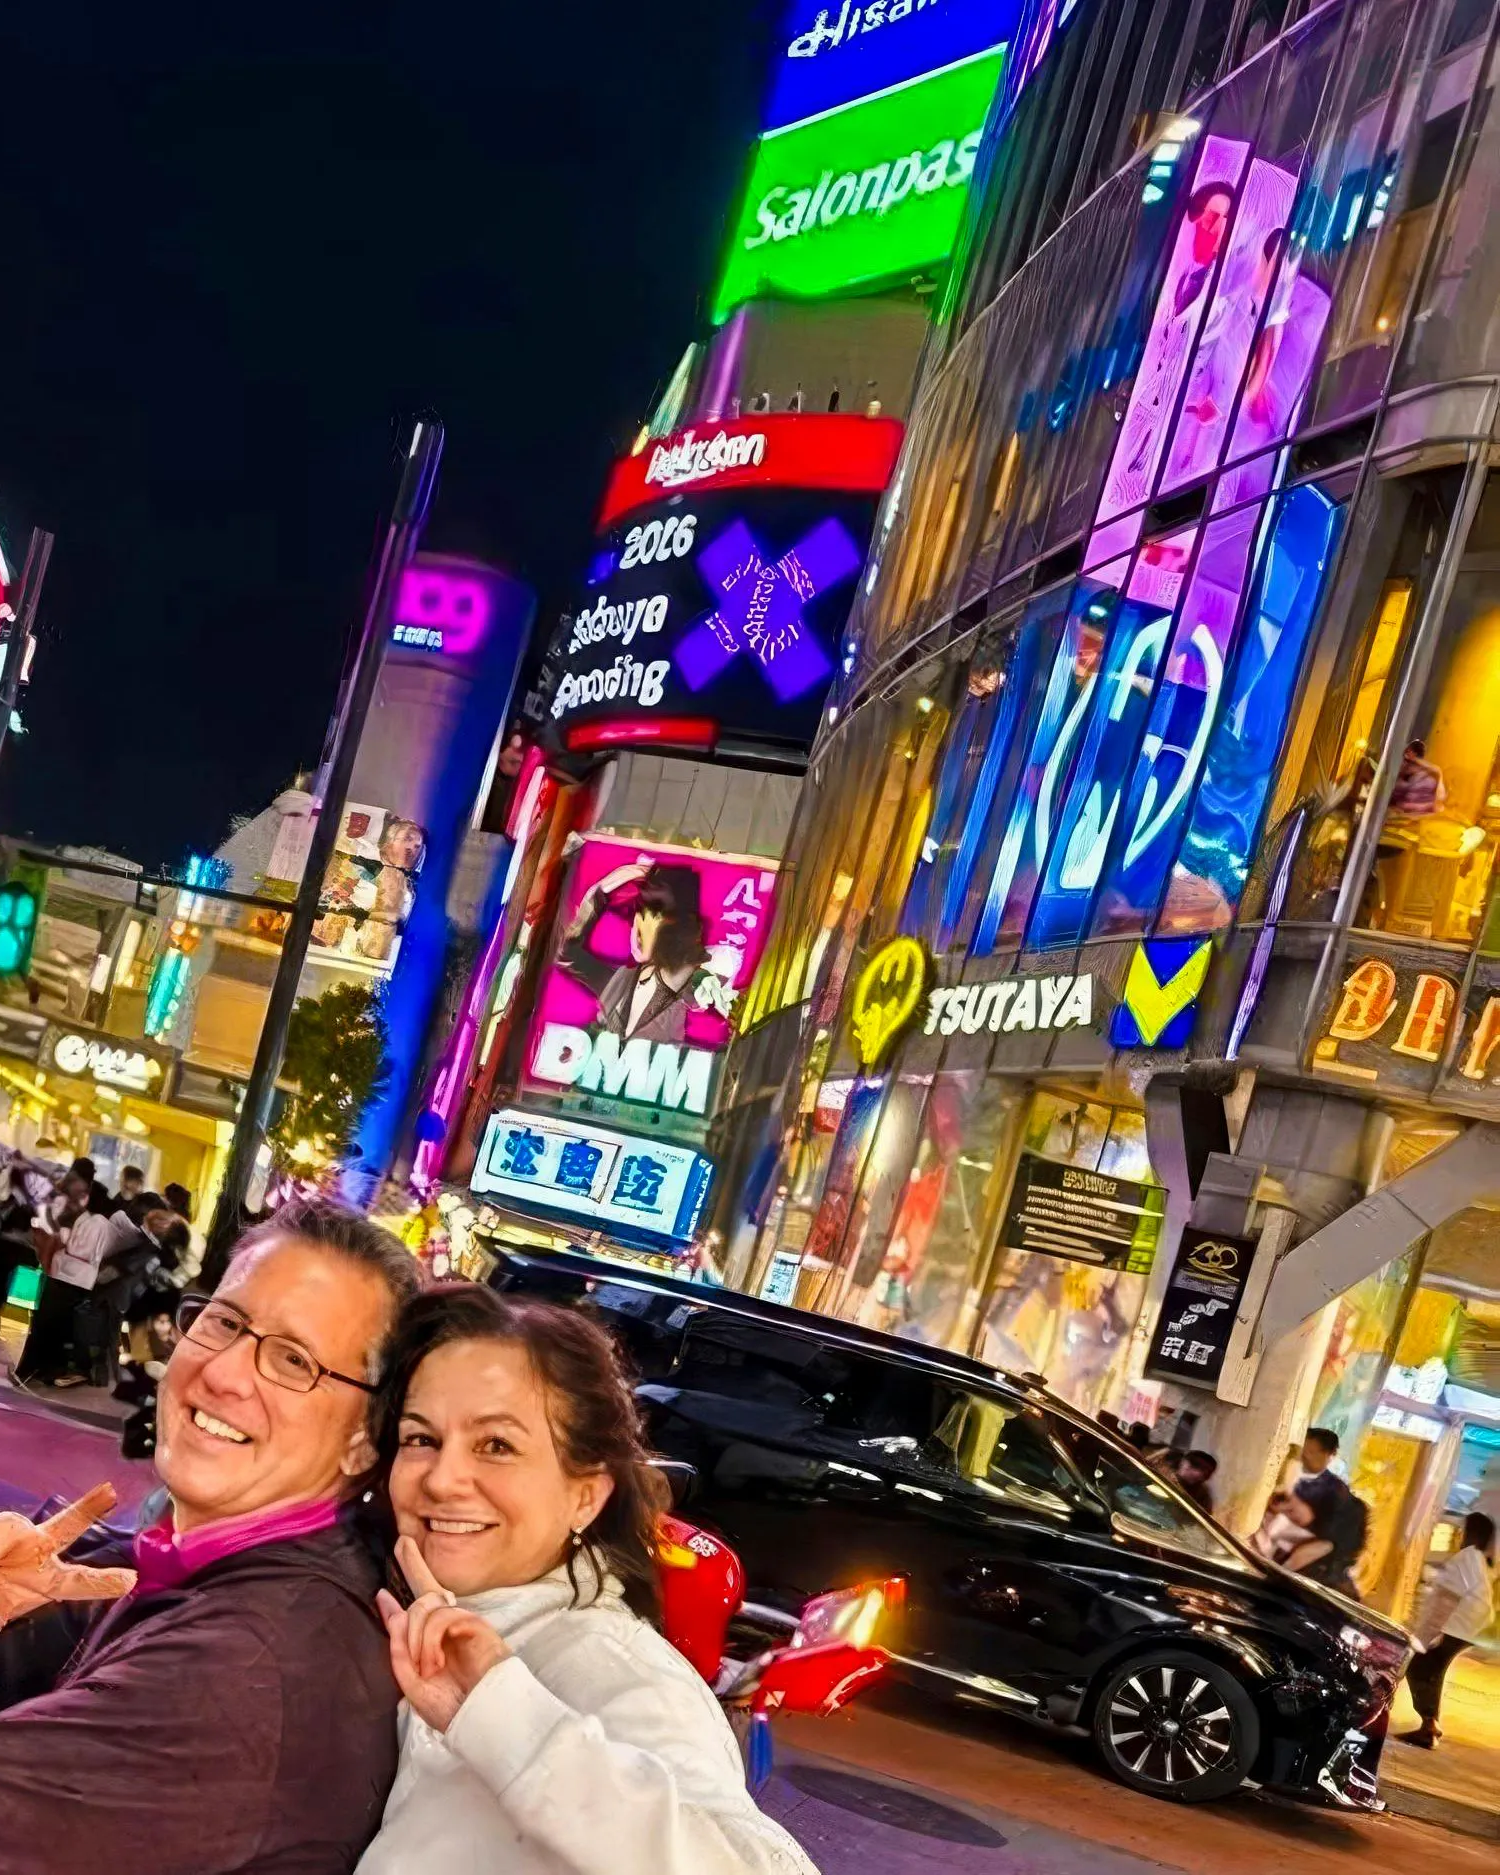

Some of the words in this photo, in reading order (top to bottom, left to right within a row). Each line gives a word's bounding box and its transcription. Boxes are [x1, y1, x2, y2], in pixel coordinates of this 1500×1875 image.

[744, 131, 983, 250] Salonpas
[923, 973, 1093, 1036] TSUTAYA
[531, 1021, 715, 1114] DMM
